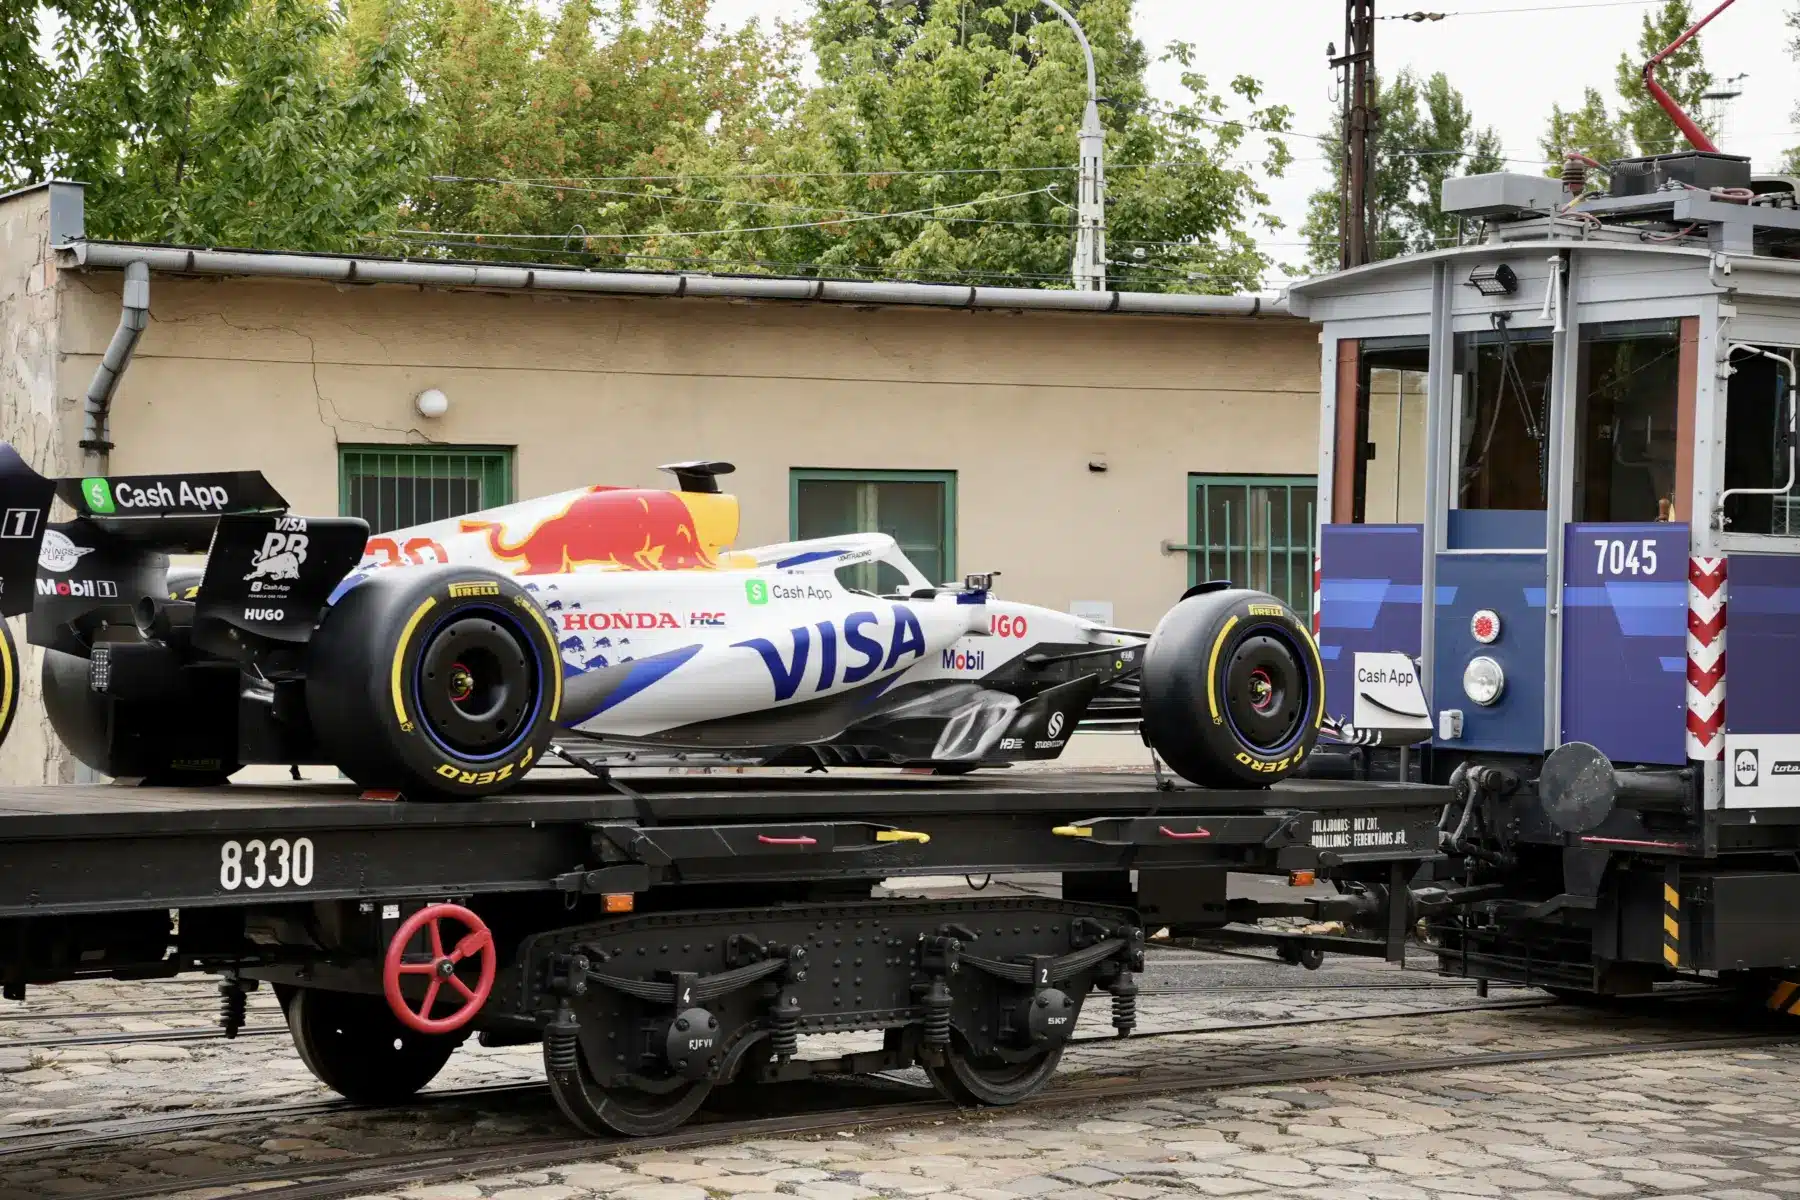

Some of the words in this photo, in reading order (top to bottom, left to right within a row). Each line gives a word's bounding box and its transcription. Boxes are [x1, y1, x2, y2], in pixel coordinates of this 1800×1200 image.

[115, 482, 176, 508] Cash
[179, 480, 229, 511] App
[14, 511, 27, 536] 1
[274, 517, 307, 532] VISA
[1594, 539, 1657, 575] 7045
[36, 579, 95, 597] Mobil
[278, 584, 291, 592] App
[448, 581, 500, 598] PIRELLI
[772, 585, 805, 599] Cash
[807, 586, 833, 601] App
[244, 608, 285, 621] HUGO
[1248, 603, 1284, 617] PIRELLI
[562, 612, 681, 631] HONDA
[729, 603, 926, 702] VISA
[942, 648, 985, 671] Mobil
[1358, 667, 1387, 683] Cash
[1388, 668, 1414, 687] App
[1235, 752, 1290, 773] ZERO
[1736, 761, 1756, 772] LIDL
[1774, 764, 1800, 773] tota
[436, 763, 515, 785] ZERO
[220, 837, 314, 891] 8330
[1041, 968, 1048, 983] 2
[683, 987, 691, 1004] 4
[1047, 1016, 1067, 1025] SKF
